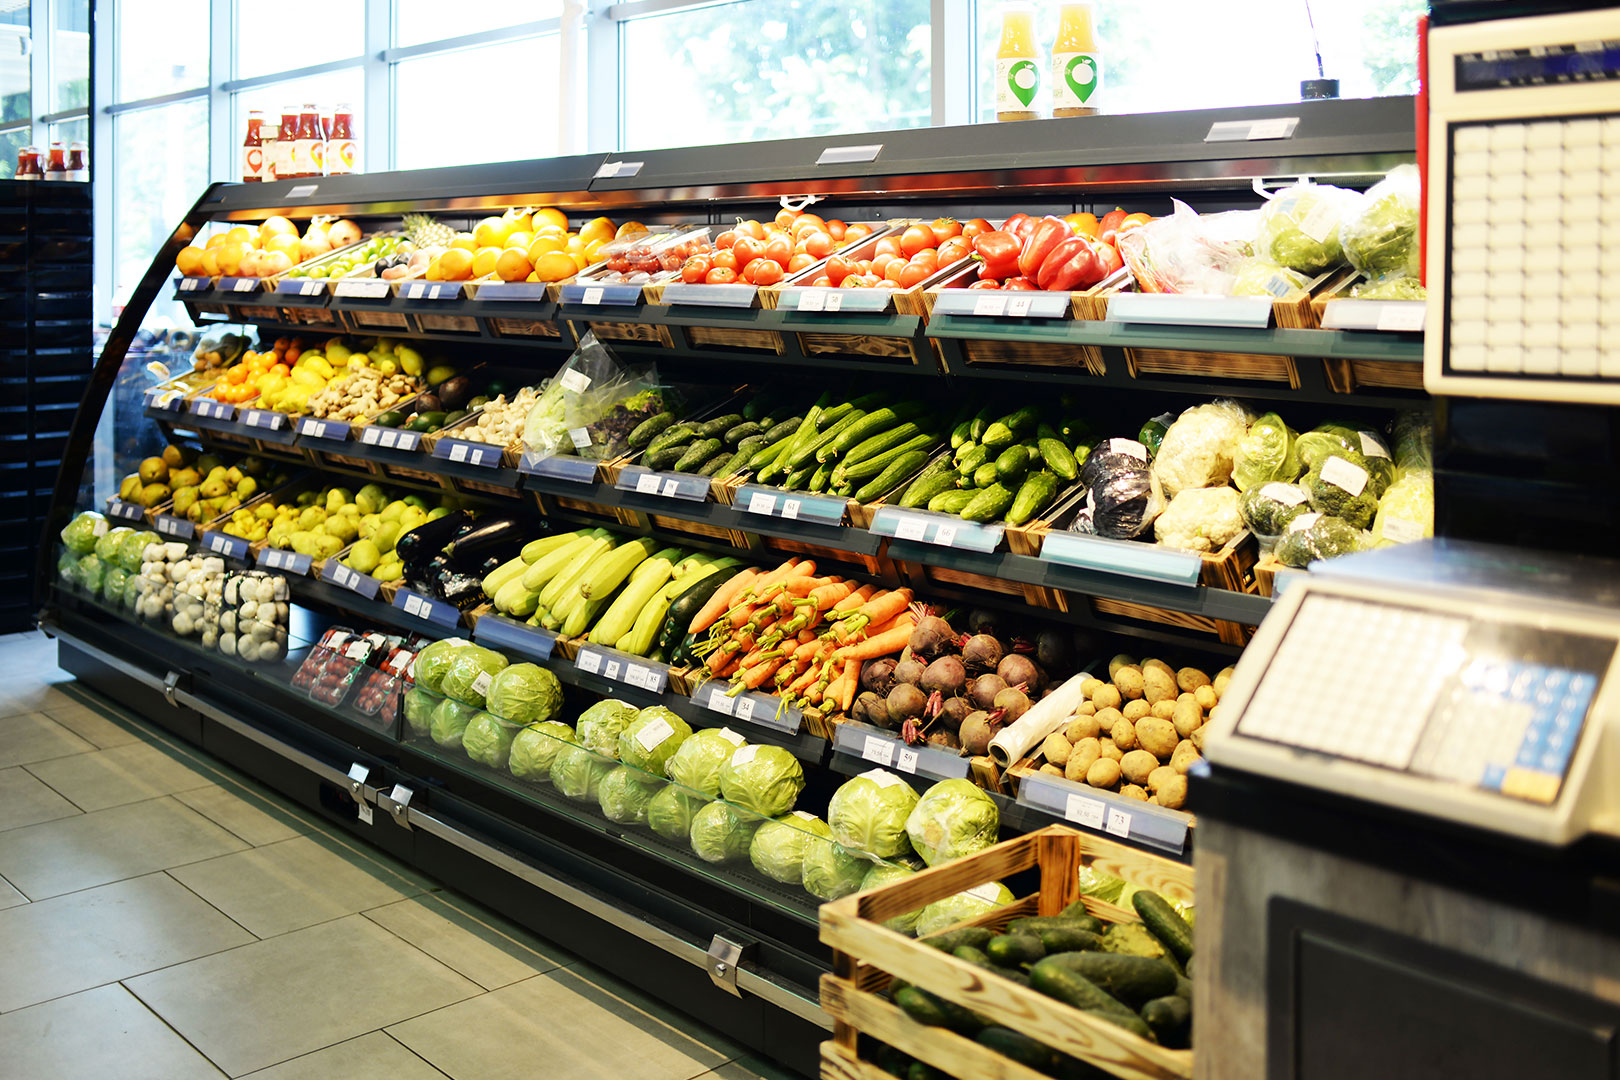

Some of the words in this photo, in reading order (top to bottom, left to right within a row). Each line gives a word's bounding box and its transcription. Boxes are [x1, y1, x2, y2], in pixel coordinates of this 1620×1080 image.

[941, 528, 951, 537] 66
[741, 702, 750, 711] 34
[903, 753, 913, 762] 59
[1114, 814, 1125, 825] 73
